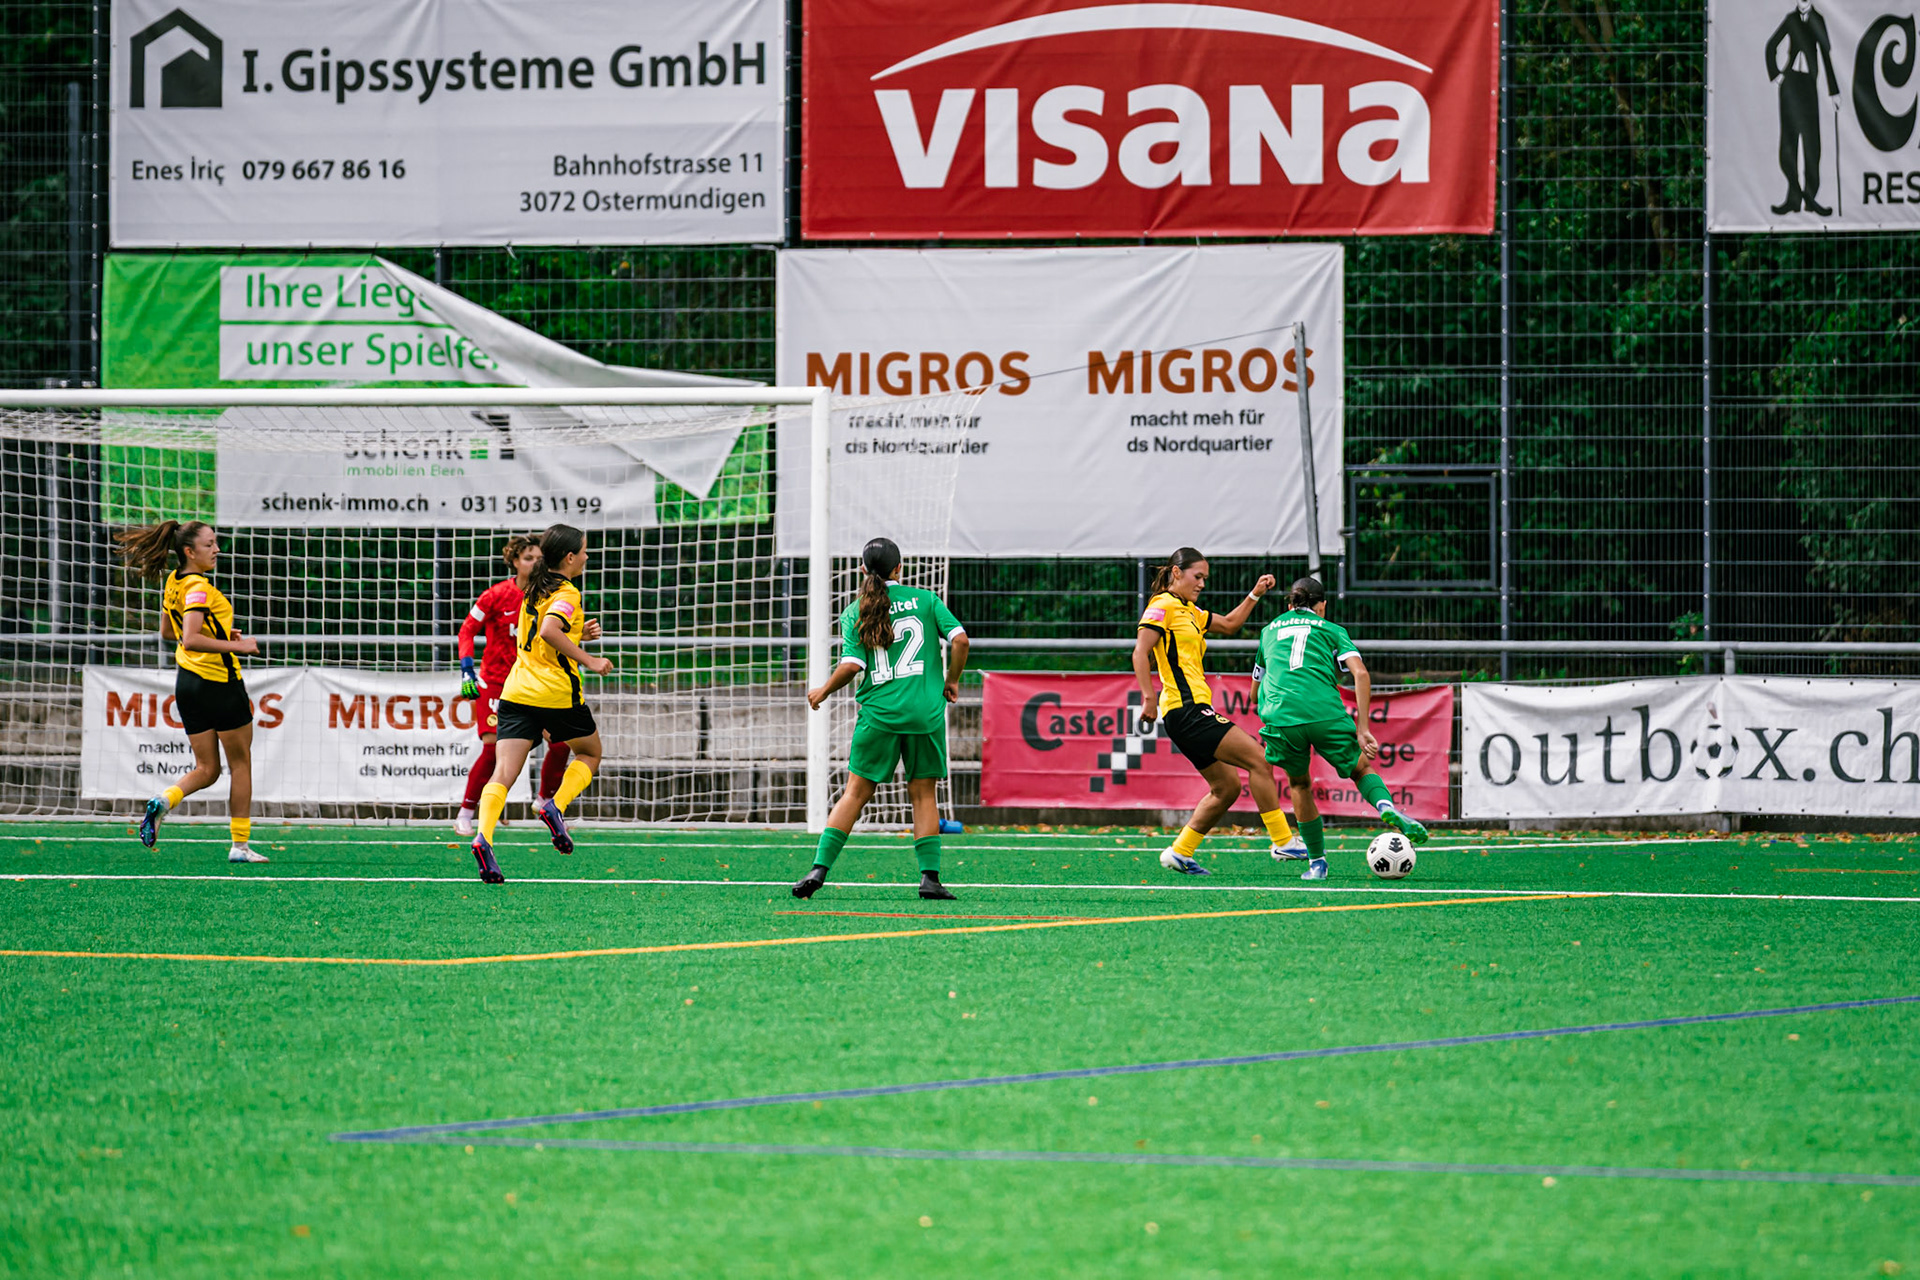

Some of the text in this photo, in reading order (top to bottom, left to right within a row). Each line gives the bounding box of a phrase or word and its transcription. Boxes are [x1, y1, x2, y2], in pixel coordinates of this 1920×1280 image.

[609, 41, 766, 87] GmbH
[1853, 13, 1920, 152] C
[132, 160, 183, 180] Enes
[242, 160, 285, 180] 079
[292, 159, 336, 180] 667
[342, 159, 371, 180] 86
[379, 159, 405, 179] 16
[553, 153, 763, 176] Bahnhofstrasse 11
[520, 187, 766, 214] 3072 Ostermundigen
[246, 273, 433, 317] Ihre Lieg
[247, 333, 498, 375] unser Spielfe
[807, 351, 1030, 396] MIGROS
[1088, 348, 1314, 394] MIGROS
[1130, 409, 1265, 427] macht meh für
[1127, 435, 1273, 455] ds Nordquartier
[343, 463, 425, 476] mmobiien
[262, 492, 602, 512] schenk-immo.ch 031 503 11 99
[888, 597, 919, 614] titel
[1277, 625, 1311, 671] 7
[328, 693, 478, 730] MIGRO
[1020, 692, 1155, 751] Castello
[138, 741, 185, 754] macht
[362, 743, 470, 756] macht meh für
[136, 761, 153, 775] ds
[359, 763, 469, 779] ds Nordquartie
